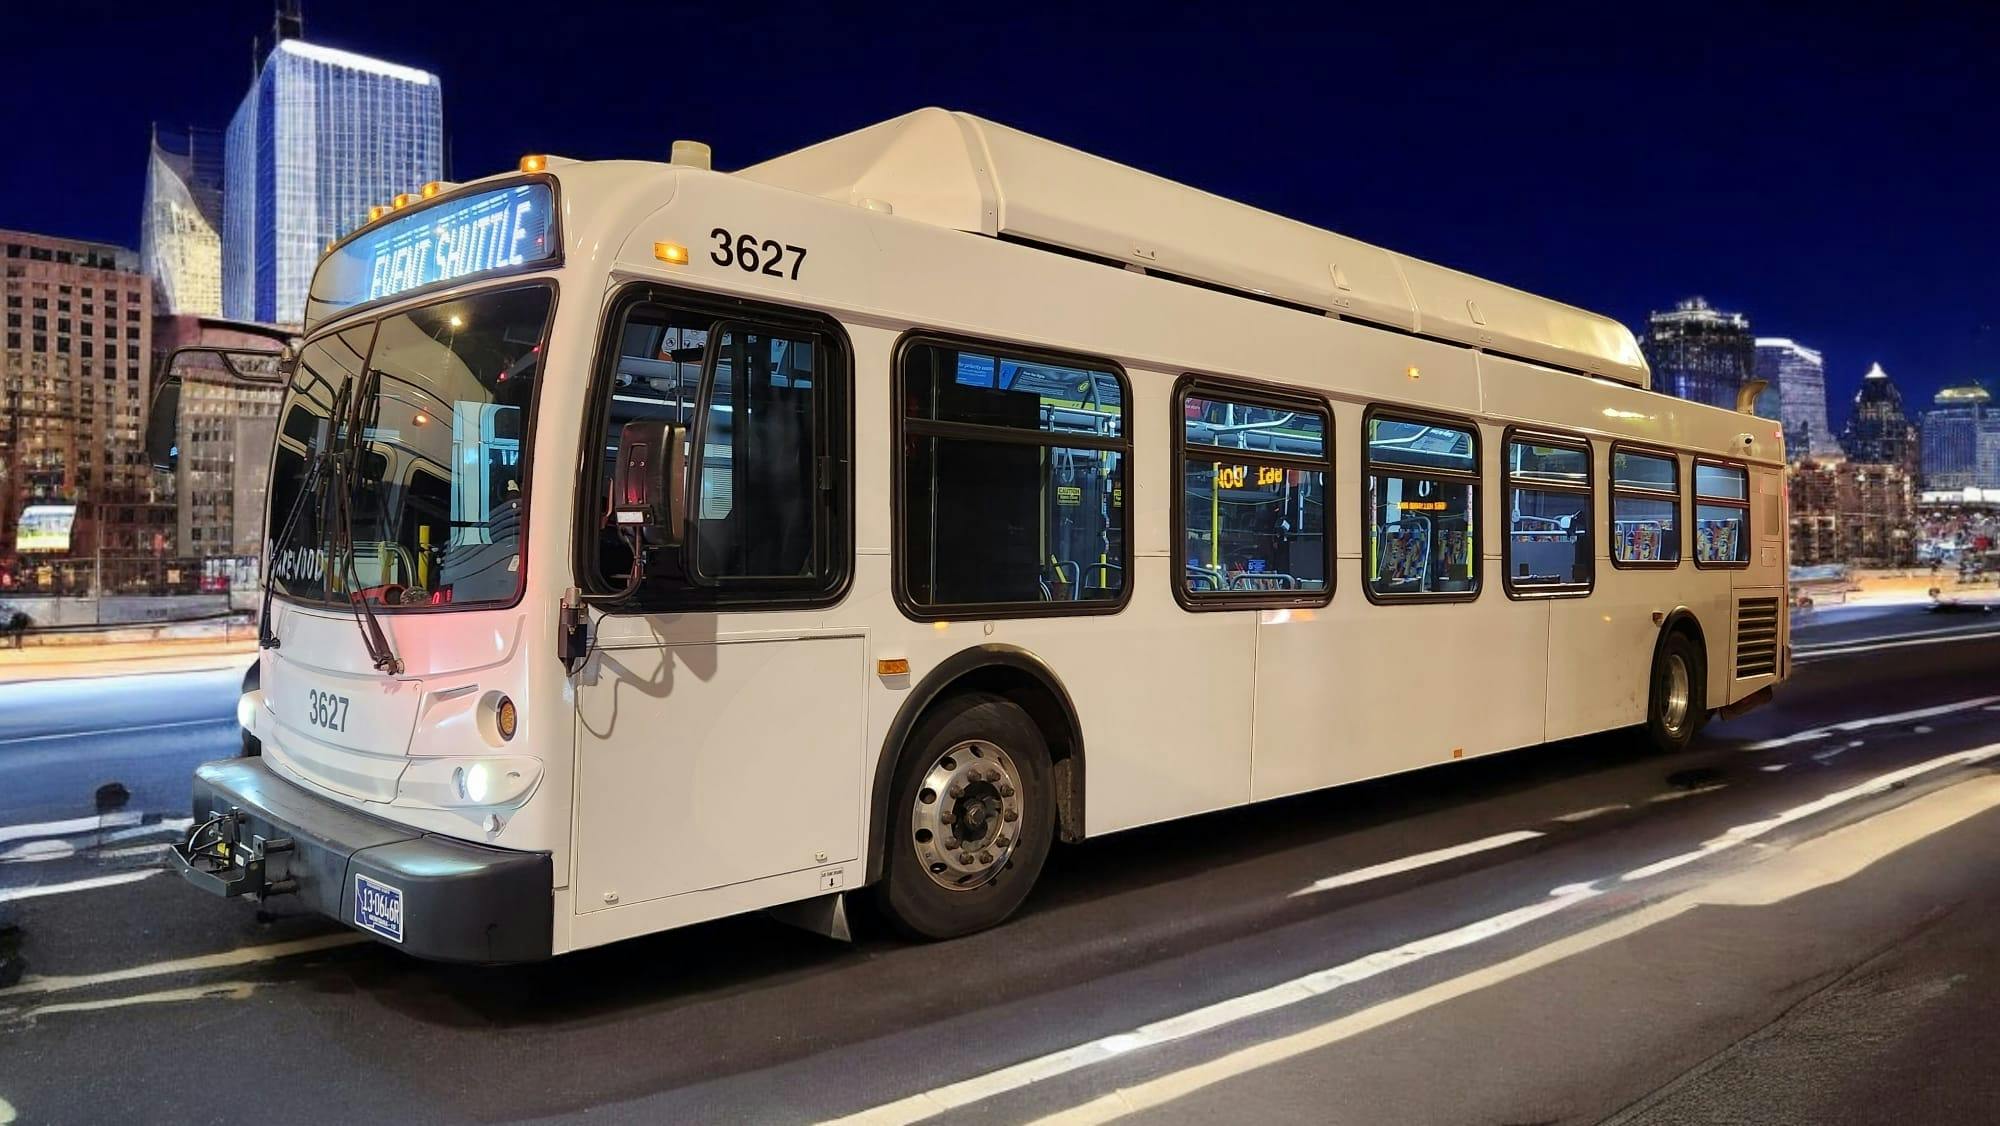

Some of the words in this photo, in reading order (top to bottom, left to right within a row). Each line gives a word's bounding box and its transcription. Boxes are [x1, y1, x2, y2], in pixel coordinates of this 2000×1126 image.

[370, 239, 433, 300] EVENT
[435, 200, 532, 280] SHUTTLE
[711, 228, 807, 280] 3627
[310, 689, 349, 732] 3627
